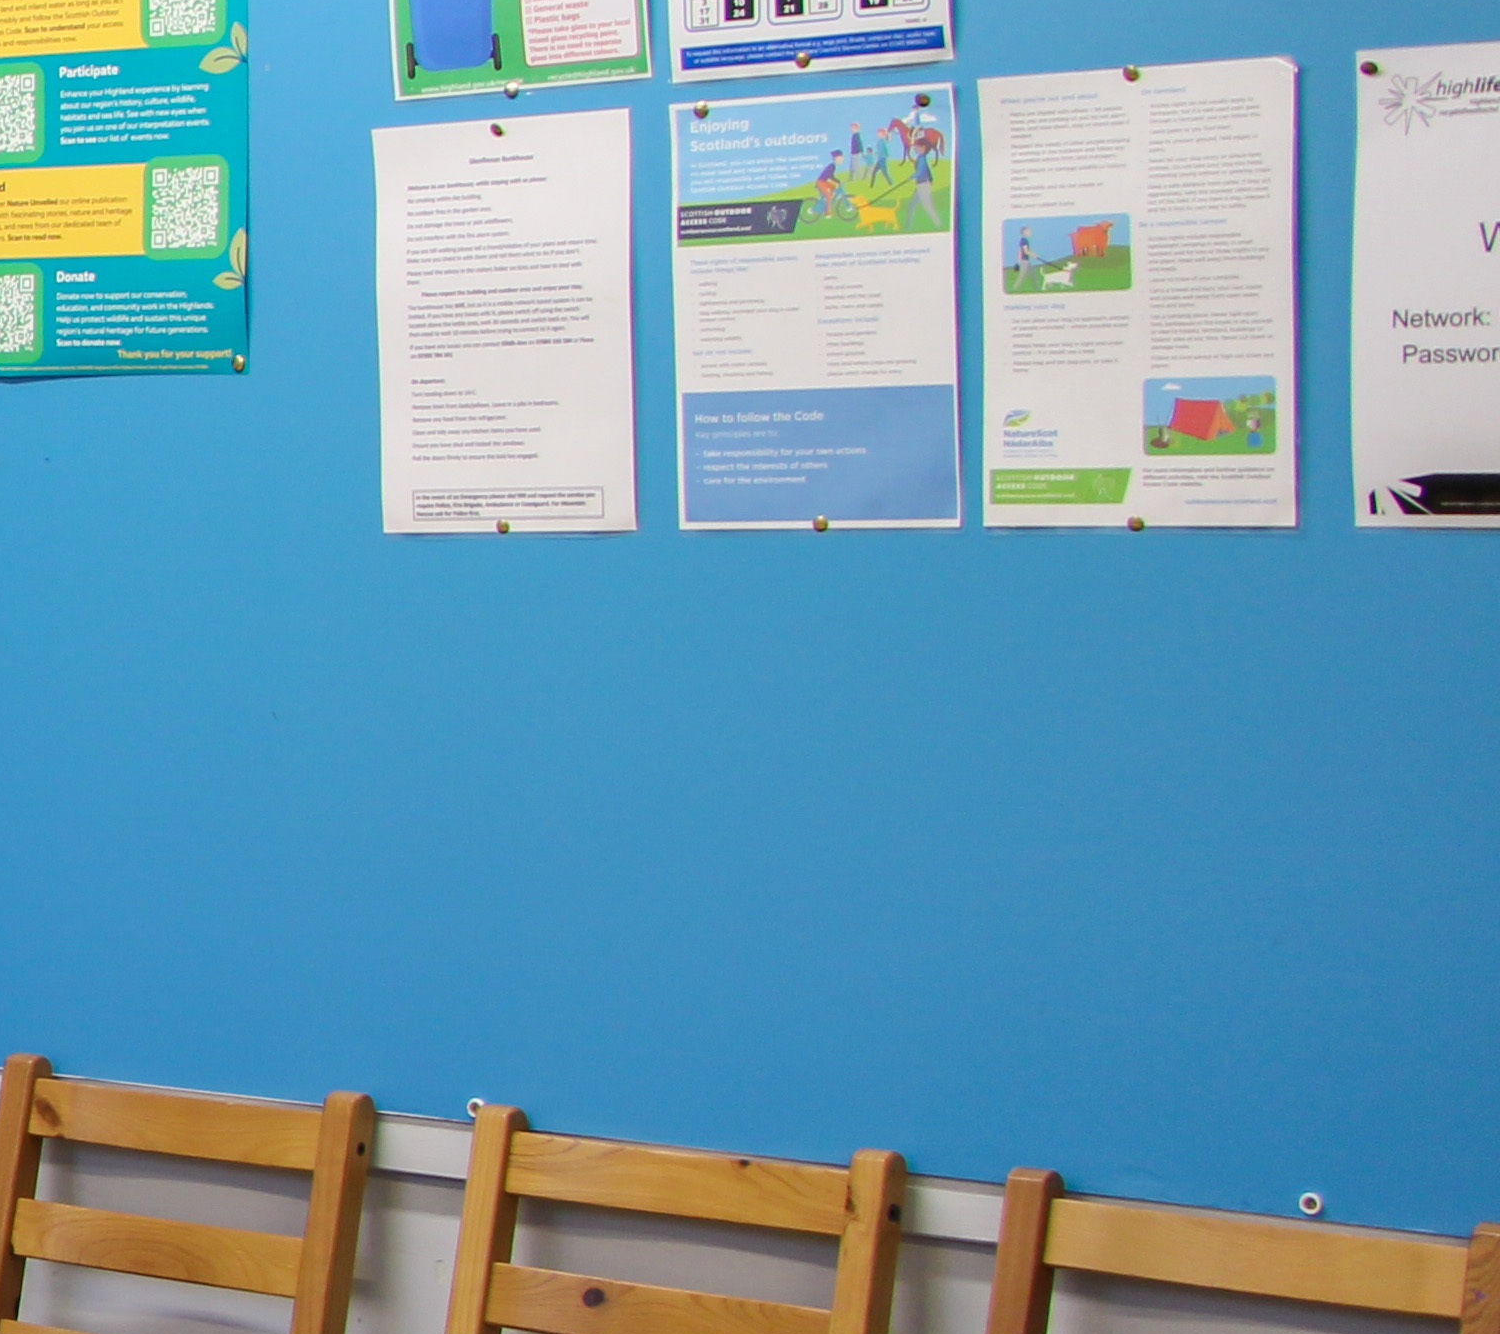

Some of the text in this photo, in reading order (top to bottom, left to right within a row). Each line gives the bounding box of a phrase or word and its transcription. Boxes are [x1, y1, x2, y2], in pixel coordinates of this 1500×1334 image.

[60, 64, 119, 78] Participate
[691, 118, 749, 135] Enjoying
[691, 133, 827, 151] Scotland's outdoors
[56, 270, 95, 281] Donate
[1392, 306, 1491, 327] Network:
[1403, 343, 1500, 362] Passwor
[695, 409, 824, 423] How to follow the Code
[780, 447, 792, 455] for
[795, 449, 813, 457] your
[736, 461, 749, 470] the
[790, 461, 798, 469] of
[723, 475, 735, 483] for
[737, 475, 751, 483] the
